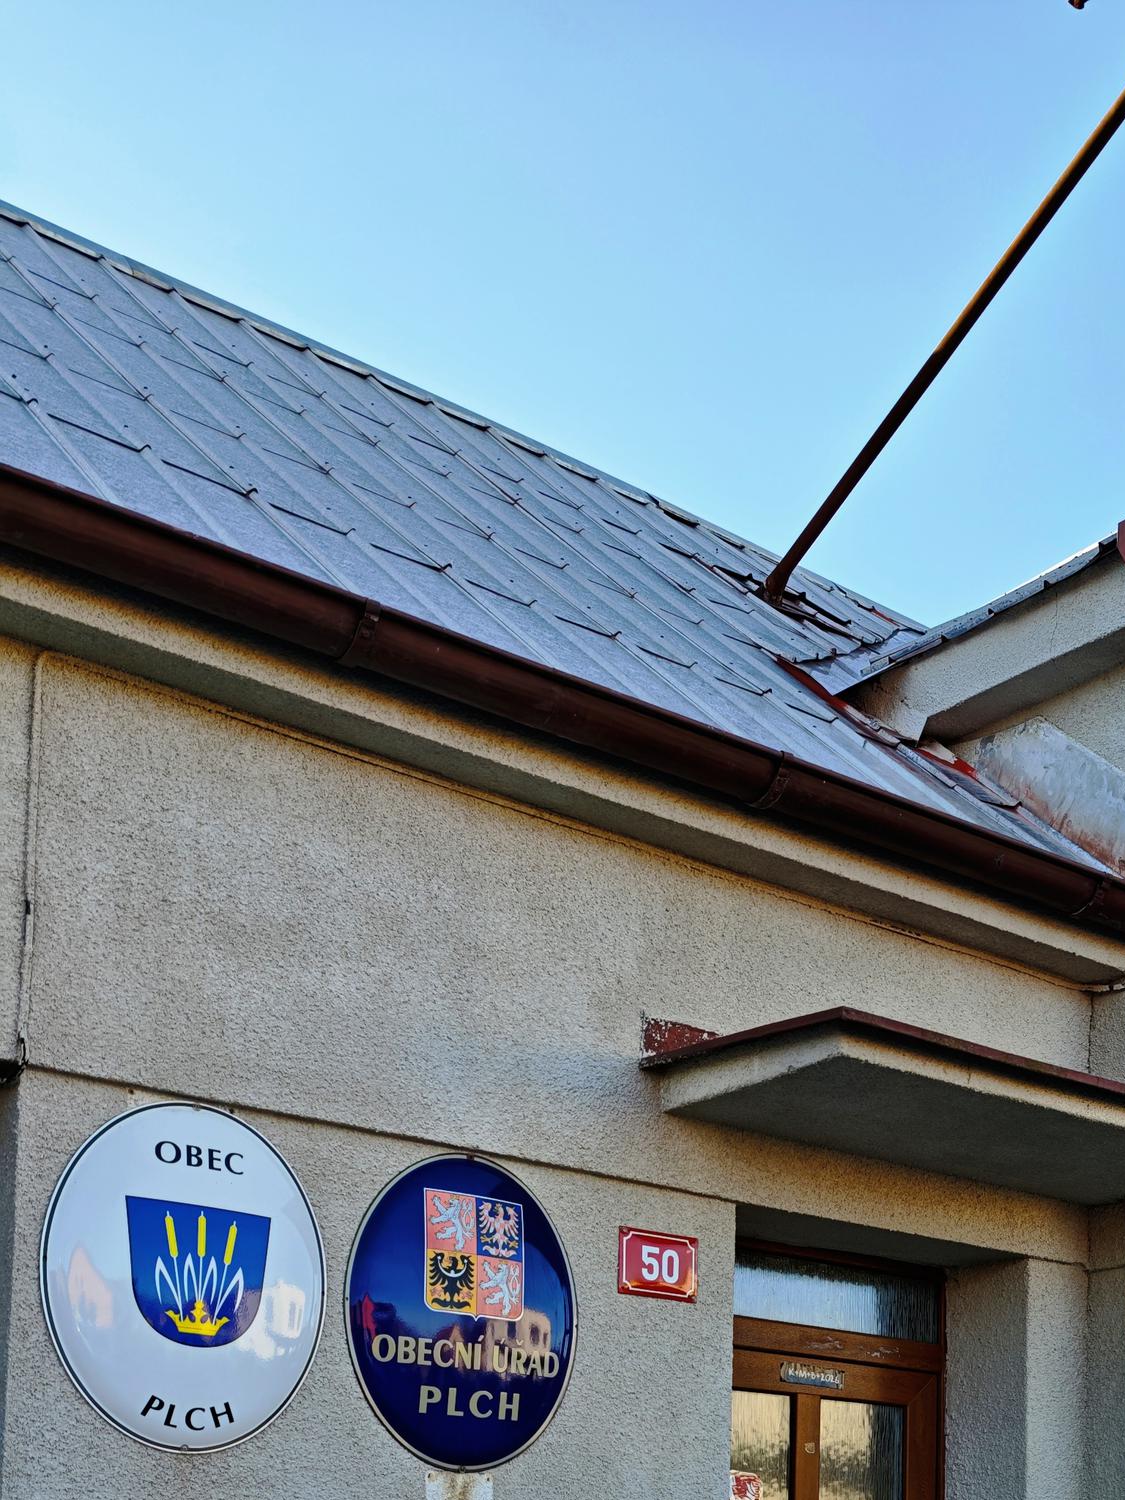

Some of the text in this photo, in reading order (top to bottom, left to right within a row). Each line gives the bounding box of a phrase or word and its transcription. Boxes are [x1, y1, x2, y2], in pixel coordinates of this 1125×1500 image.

[154, 1140, 245, 1176] OBEC
[641, 1244, 680, 1284] 50
[371, 1333, 561, 1379] OBECNÍ ÚŘAD
[140, 1394, 236, 1431] PLCH
[418, 1384, 521, 1422] PLCH
